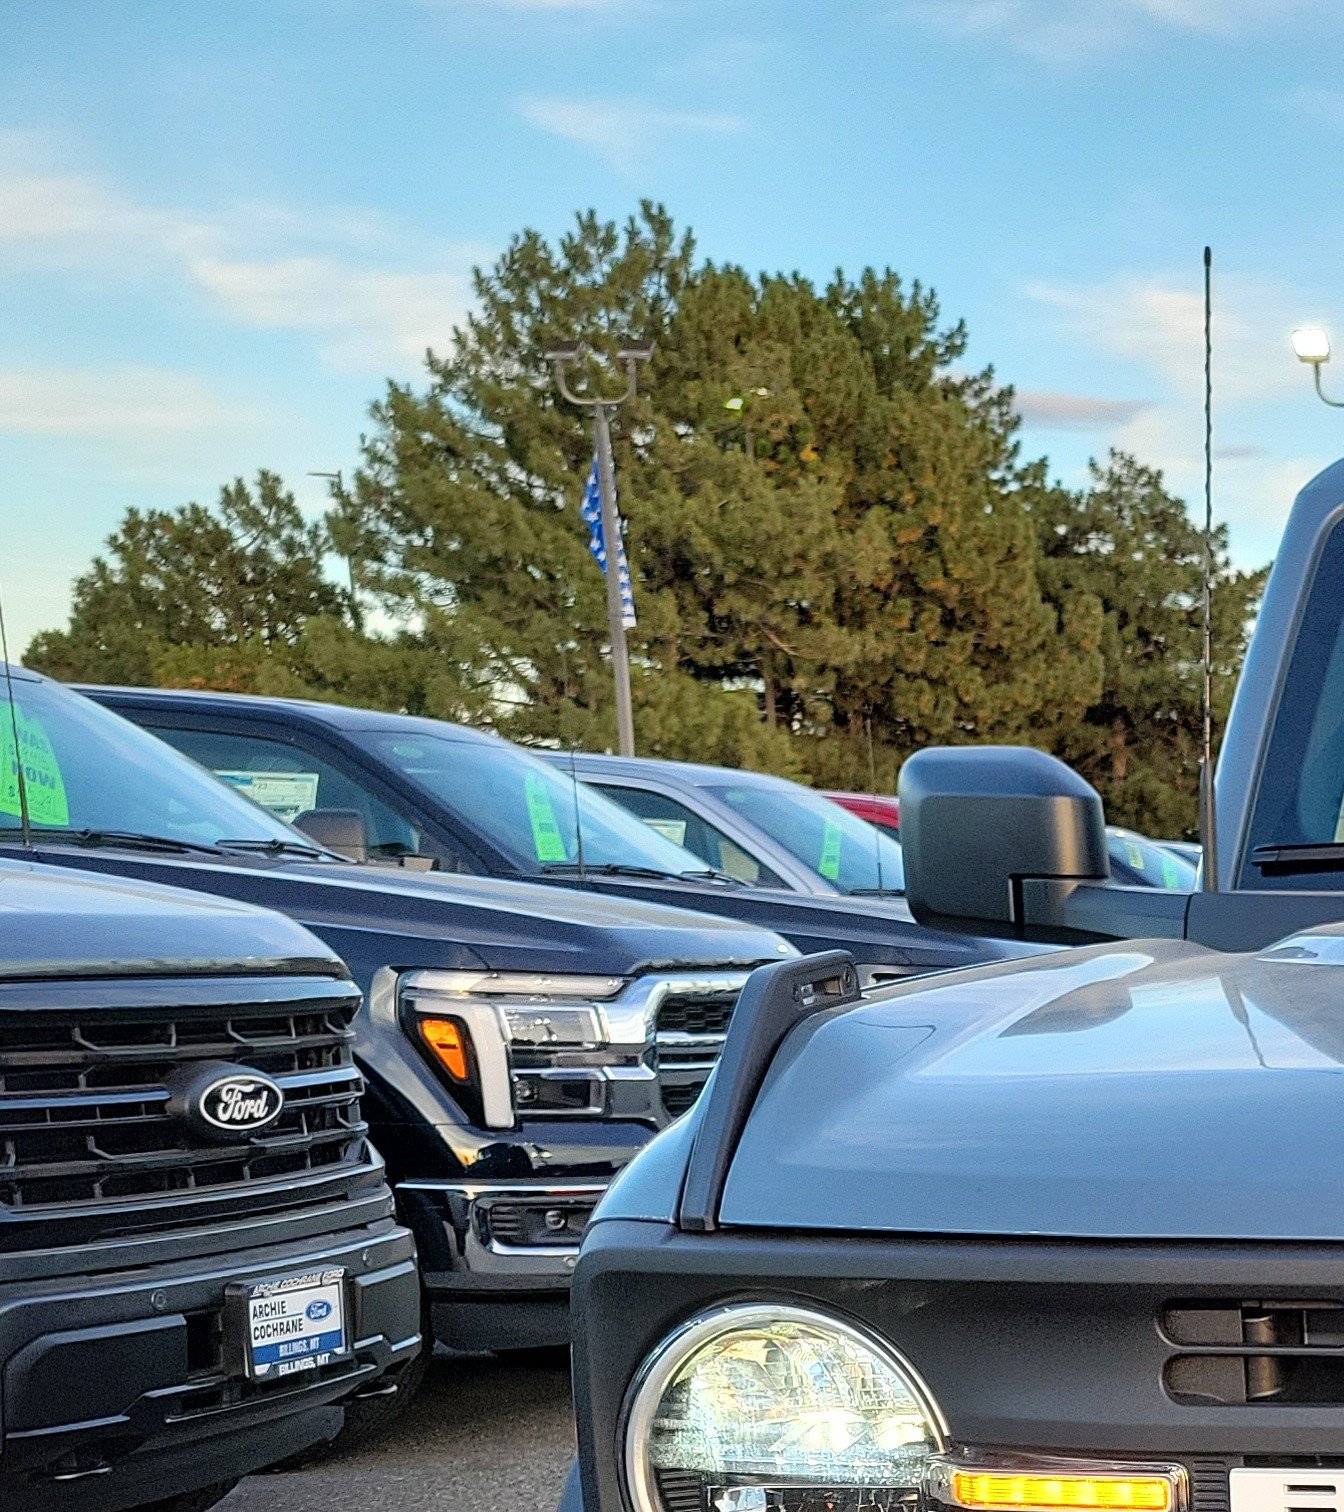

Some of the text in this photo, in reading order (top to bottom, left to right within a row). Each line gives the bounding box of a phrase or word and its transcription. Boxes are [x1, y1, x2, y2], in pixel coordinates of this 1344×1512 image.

[217, 1083, 268, 1121] Ford
[253, 1300, 287, 1319] ARCHIE
[253, 1318, 303, 1340] COCHRANE
